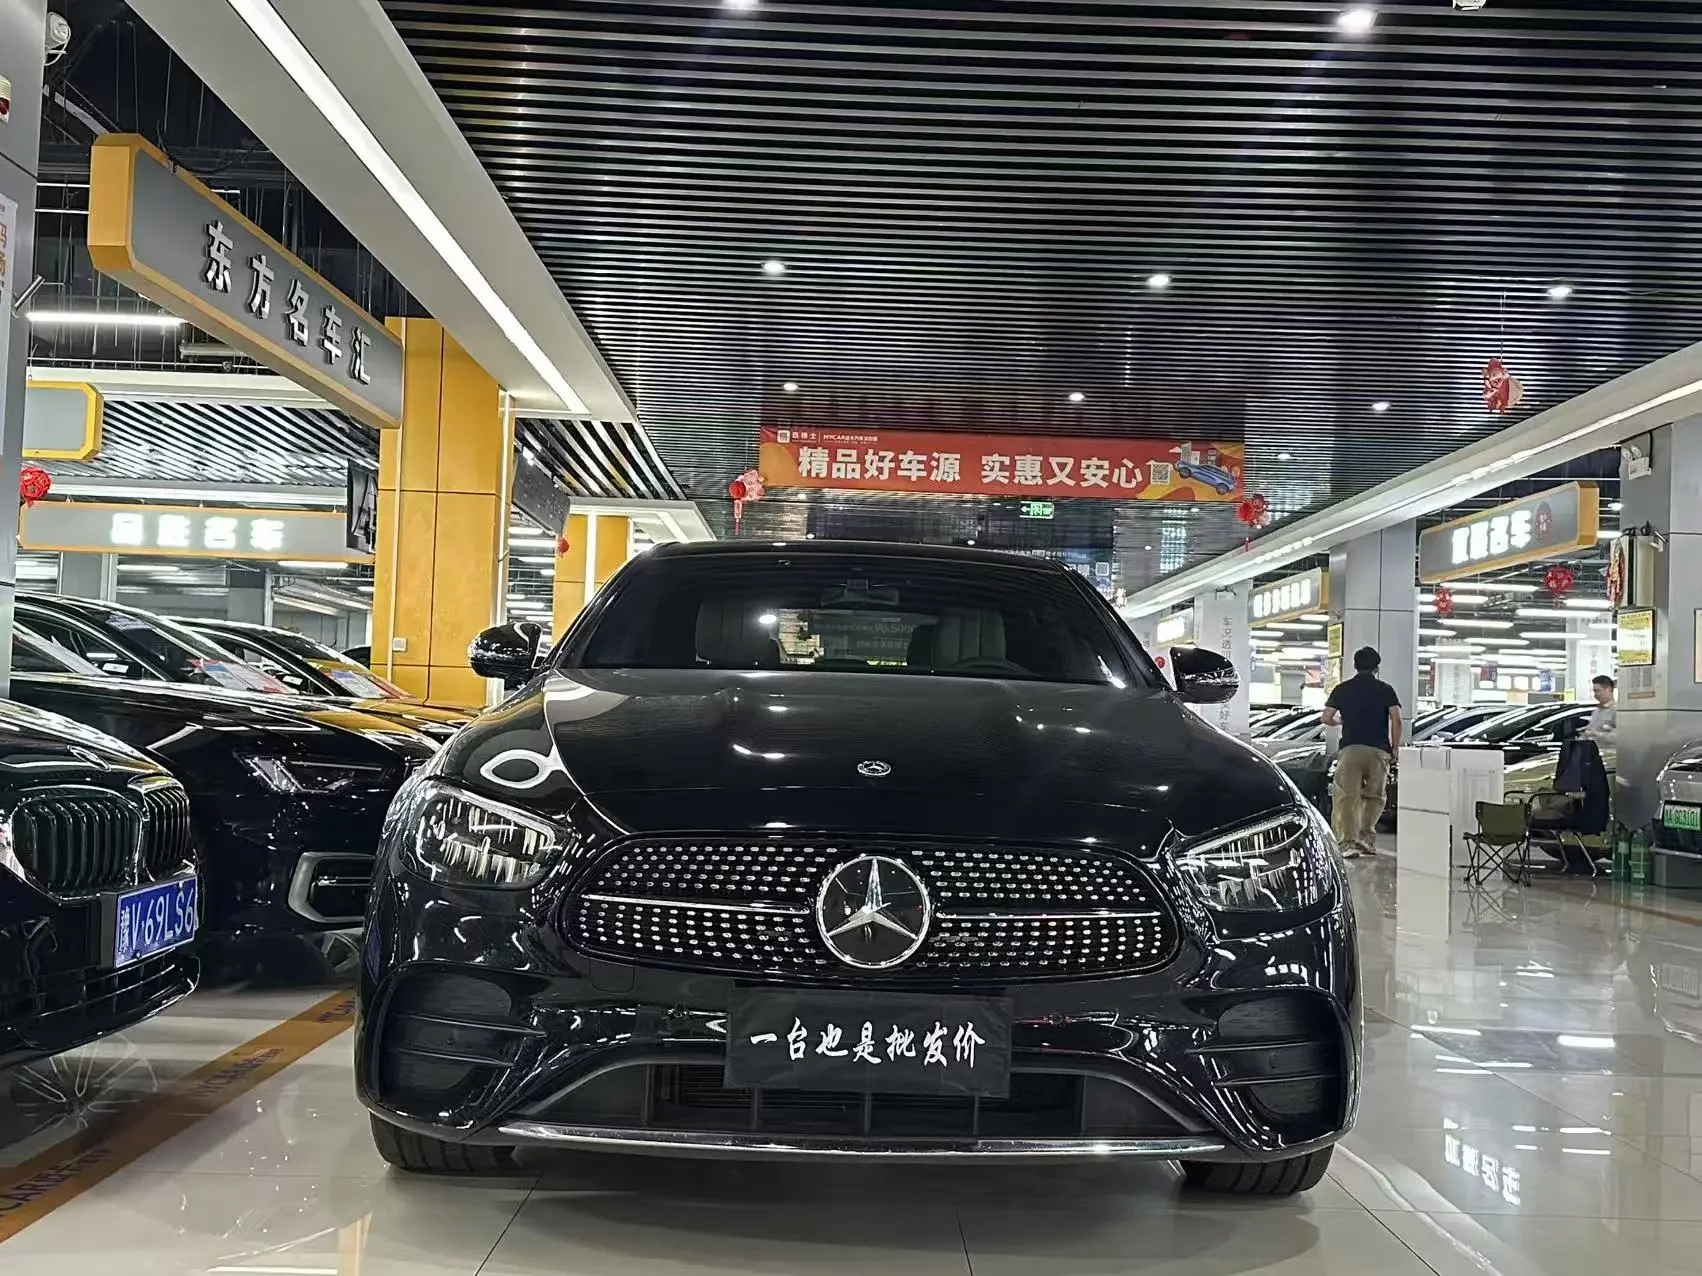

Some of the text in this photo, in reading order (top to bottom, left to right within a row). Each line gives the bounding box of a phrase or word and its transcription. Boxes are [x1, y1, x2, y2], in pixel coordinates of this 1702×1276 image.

[204, 220, 372, 385] 东方名车汇
[798, 446, 1143, 489] 精品好车源 实惠又安心
[750, 1016, 986, 1069] 一台也是批发价
